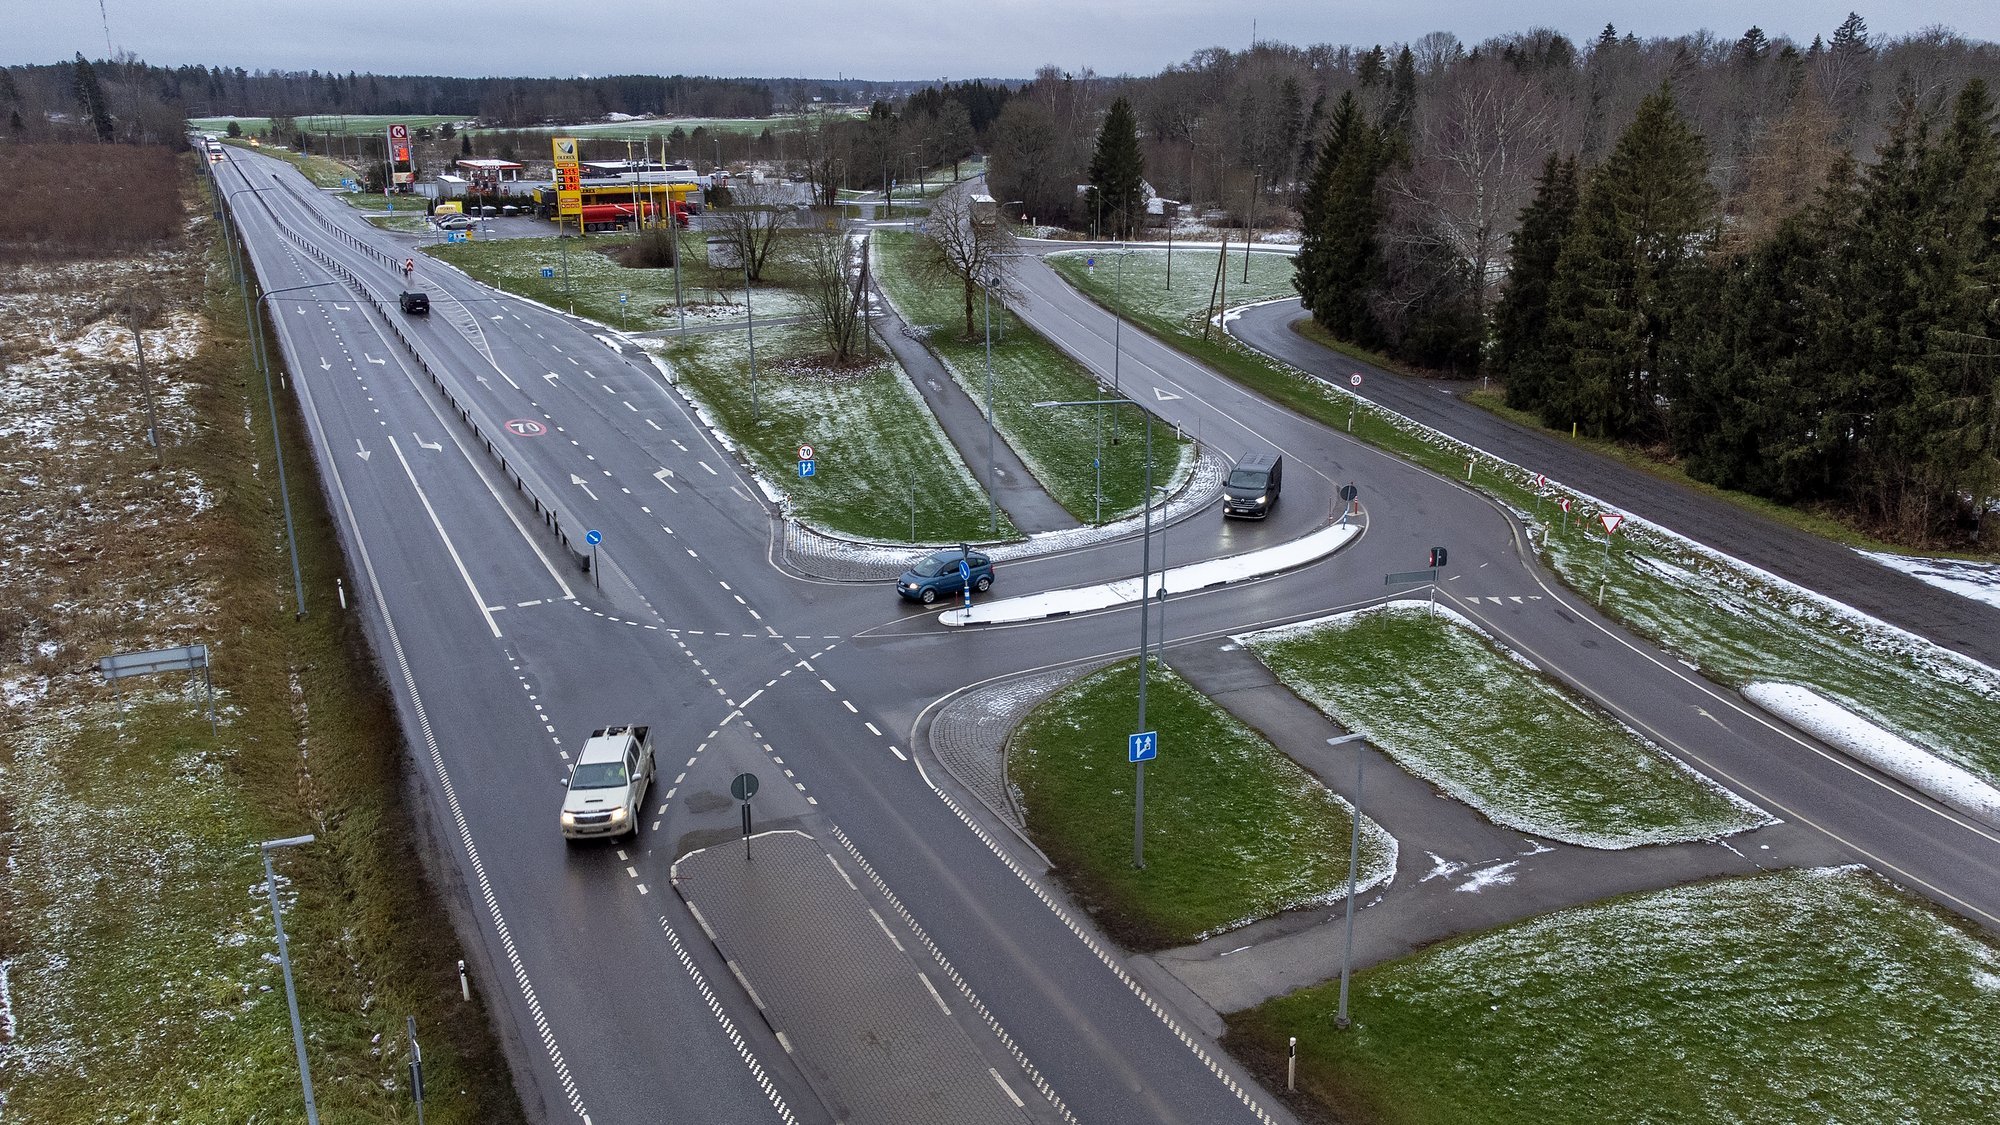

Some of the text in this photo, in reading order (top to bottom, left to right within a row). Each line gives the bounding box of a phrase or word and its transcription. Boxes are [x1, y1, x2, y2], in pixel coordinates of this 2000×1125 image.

[395, 128, 403, 136] K
[510, 422, 540, 433] 70
[801, 448, 811, 457] 70
